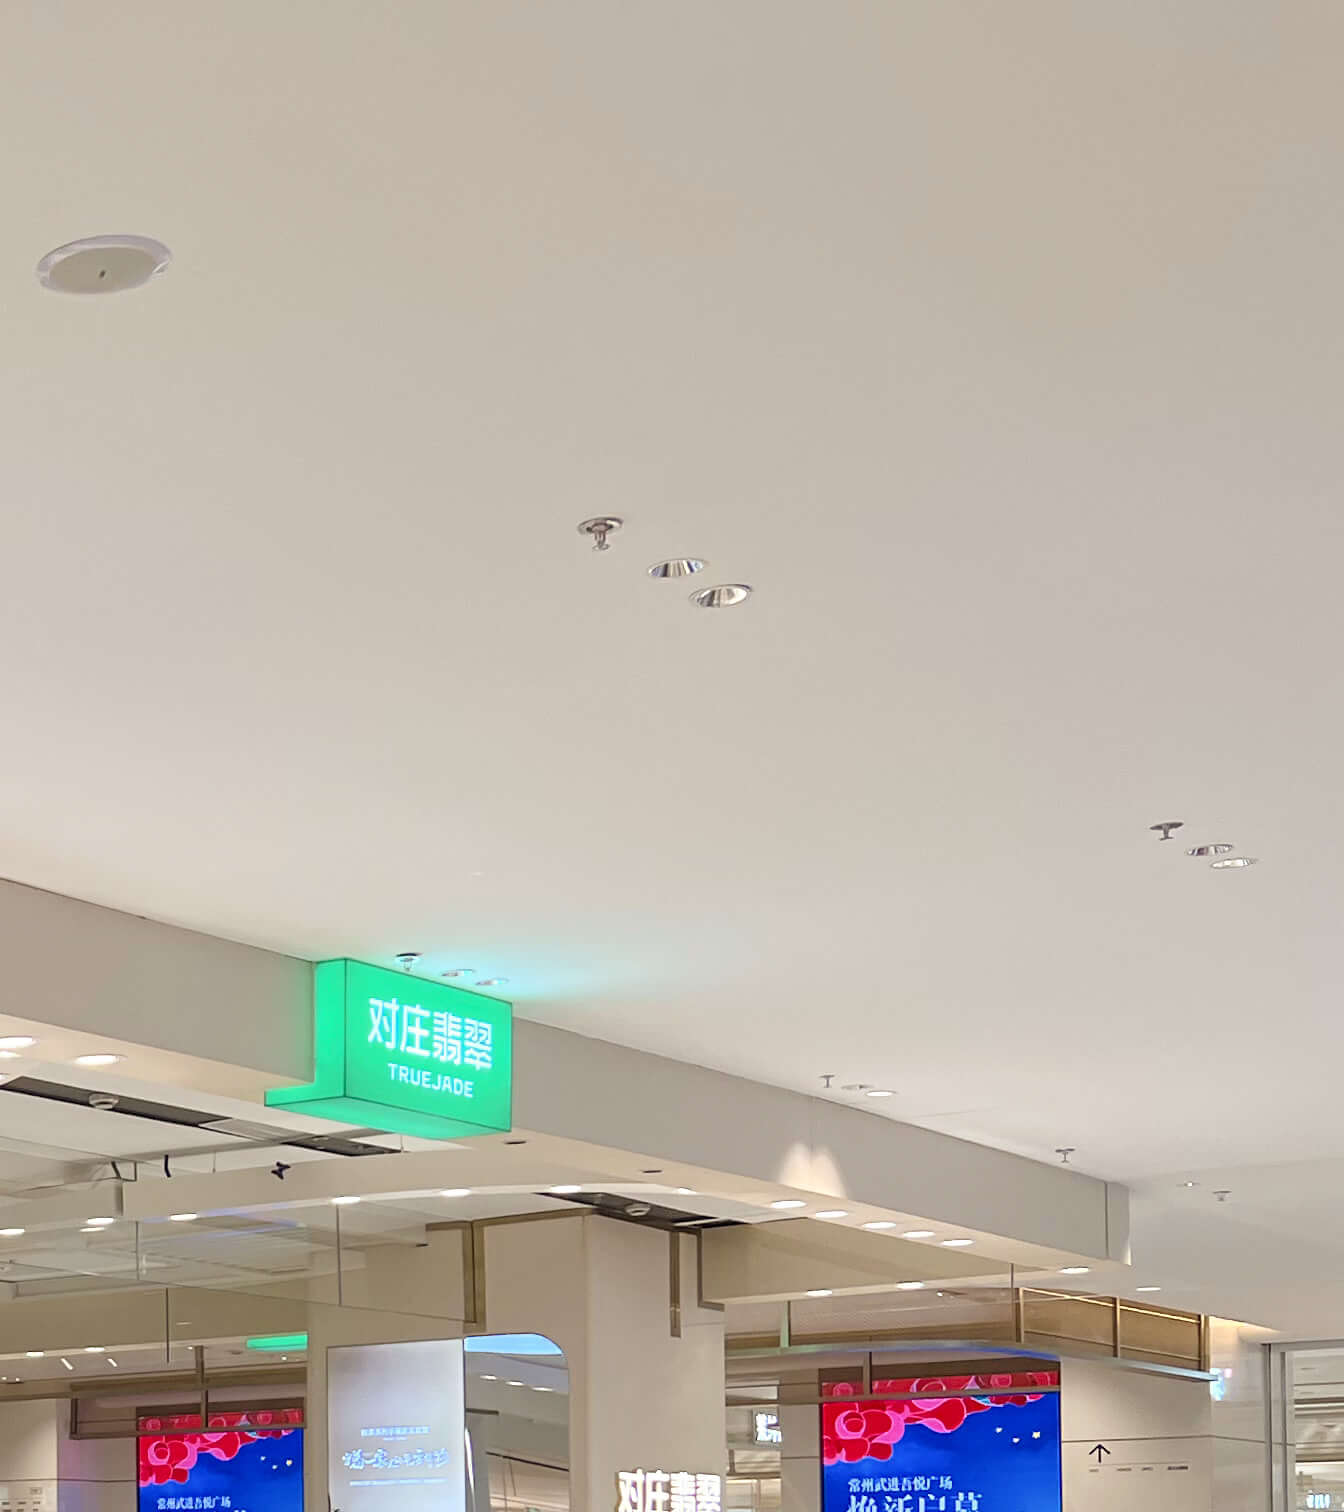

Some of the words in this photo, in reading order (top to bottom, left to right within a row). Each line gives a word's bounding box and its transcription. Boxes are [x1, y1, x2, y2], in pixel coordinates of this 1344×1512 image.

[367, 997, 493, 1071] 对庄翡翠
[387, 1062, 474, 1099] TRUEJADE
[847, 1475, 953, 1493] 常州武进吾悦广场
